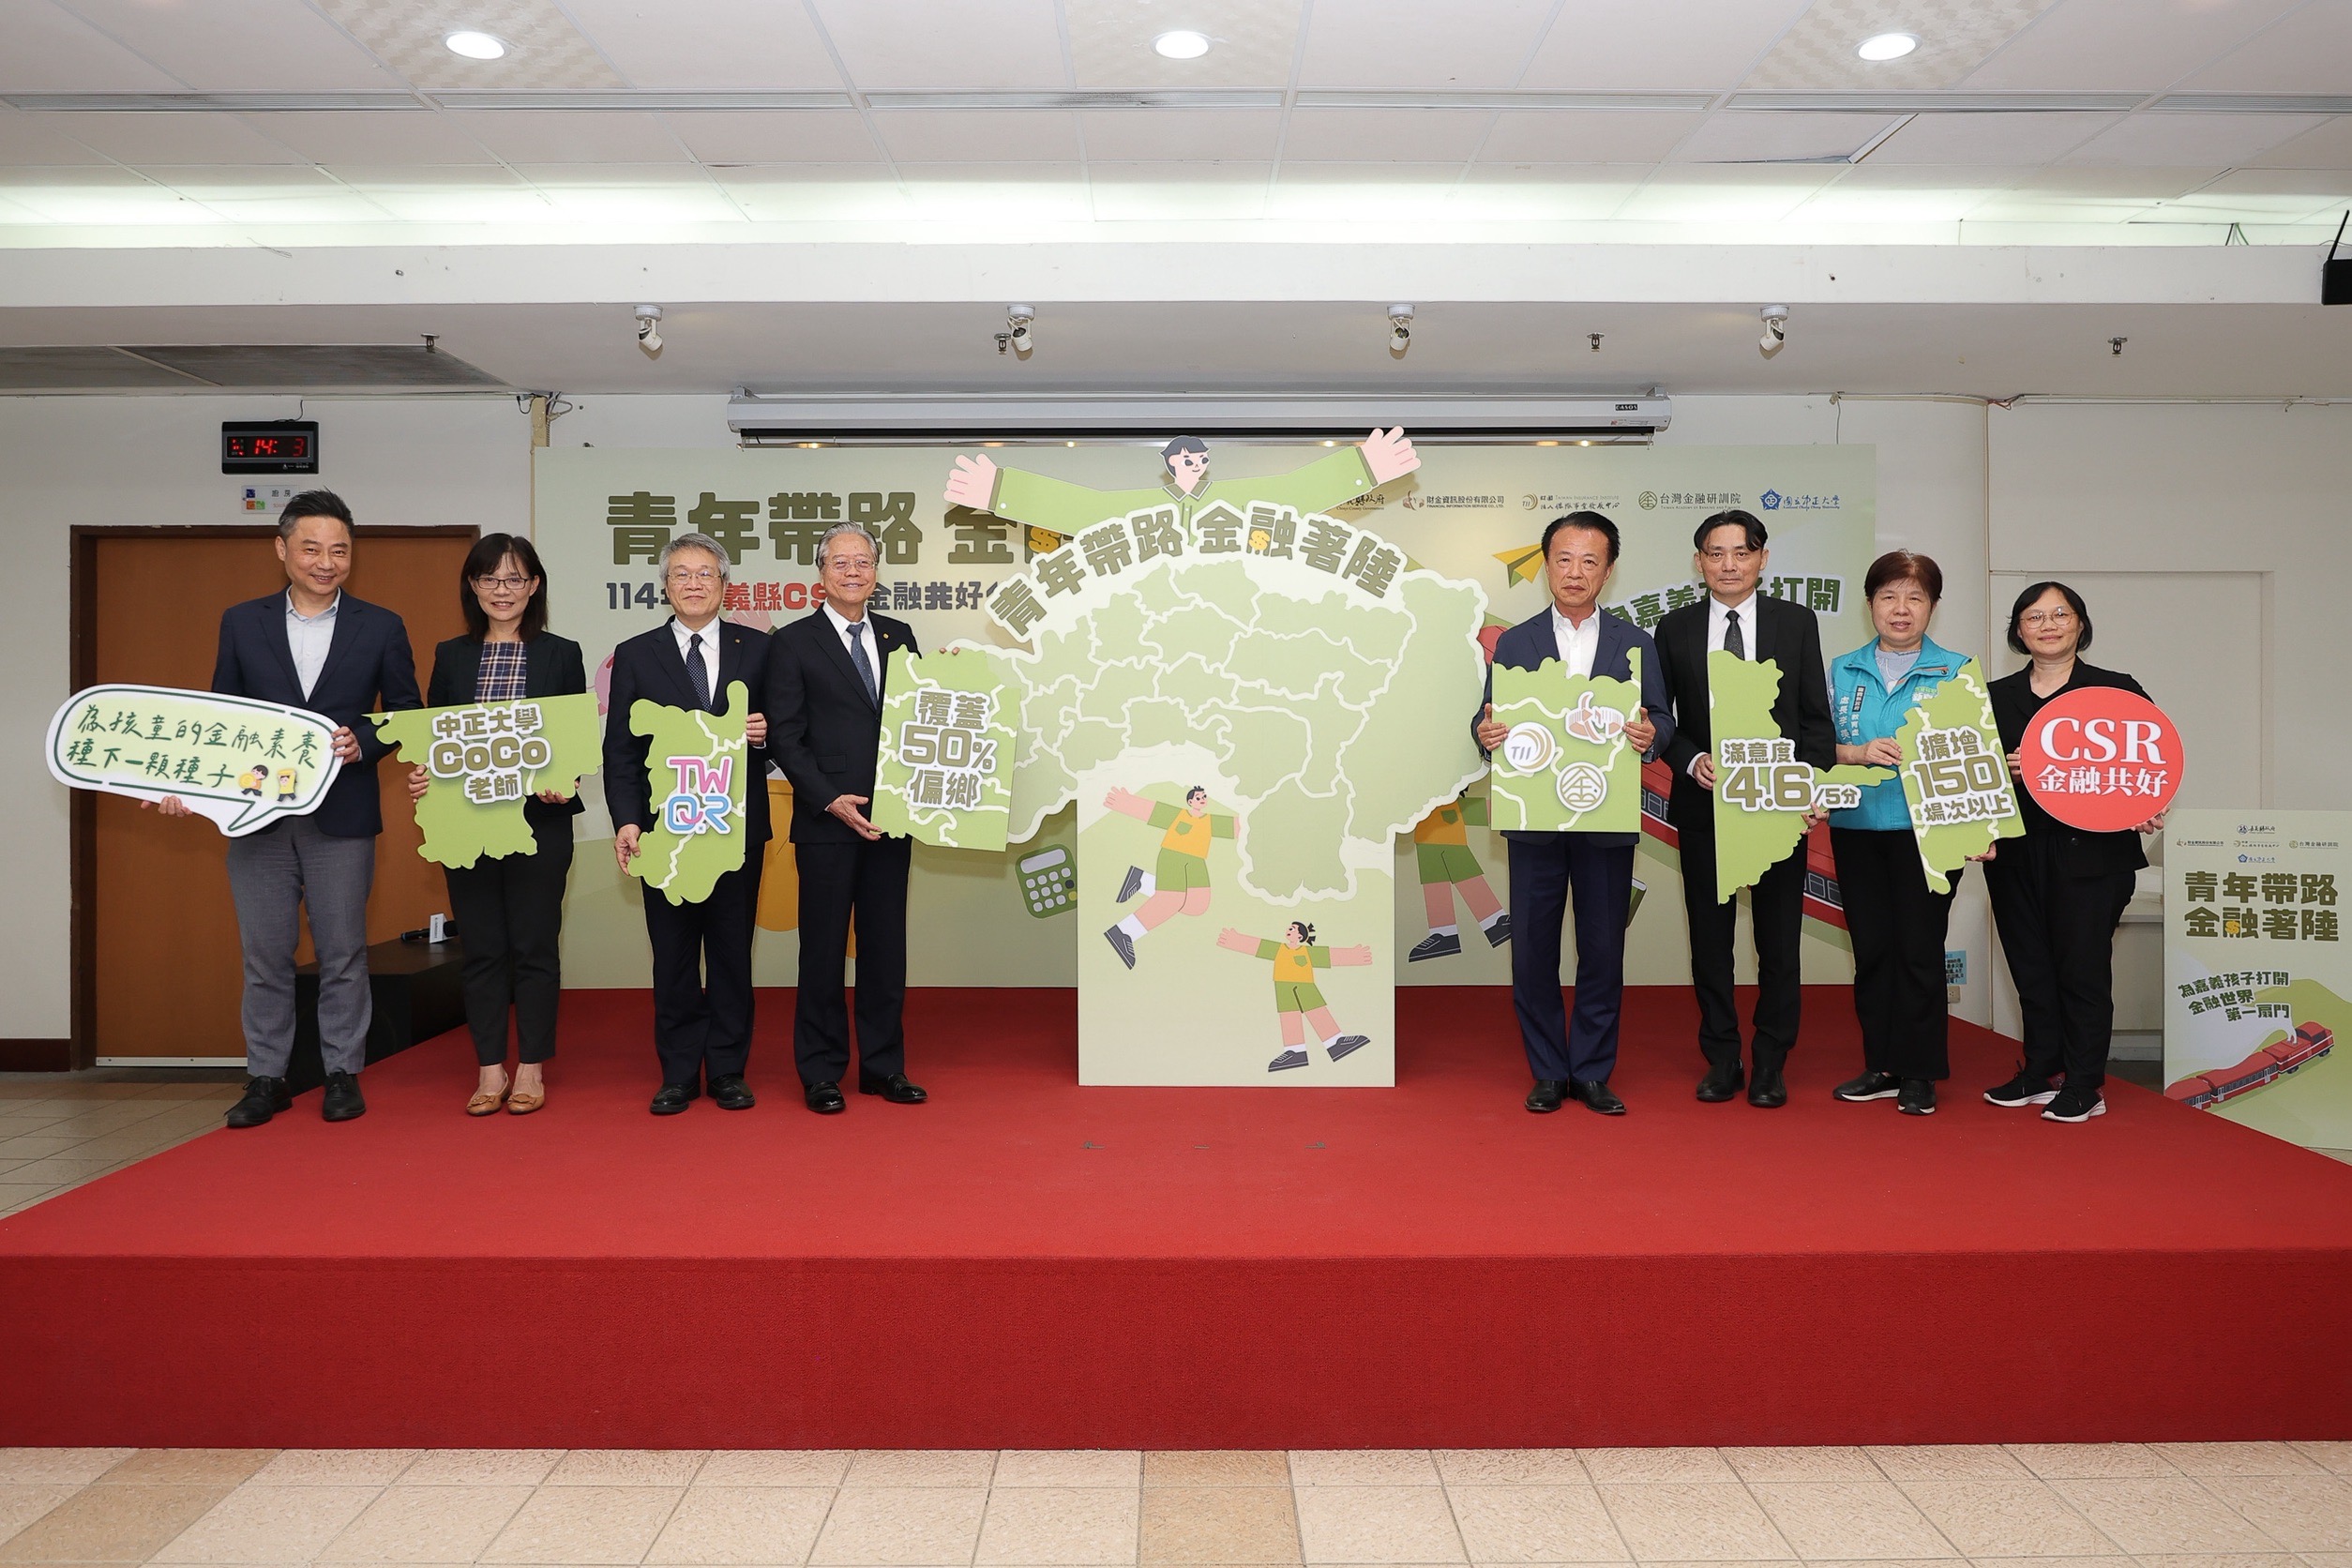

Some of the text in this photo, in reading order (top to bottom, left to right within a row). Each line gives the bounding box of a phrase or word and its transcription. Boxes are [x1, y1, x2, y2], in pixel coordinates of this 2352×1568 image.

[1426, 495, 1504, 504] 財金資訊股份有限公司
[1660, 492, 1741, 505] 台灣金融研訓院
[607, 491, 922, 565] 青年帶路
[990, 505, 1401, 636] 青年帶路 金融著陸
[436, 707, 538, 738] 中正大學
[918, 690, 987, 731] 覆蓋
[78, 704, 318, 769] 為孩童的金融素養
[902, 725, 994, 770] 50%
[1725, 741, 1791, 764] 滿意度
[1921, 730, 1978, 761] 擴增
[2040, 716, 2167, 764] CSR
[67, 738, 234, 788] 種下一顆種子
[433, 736, 547, 774] CoCo
[468, 774, 519, 800] 老師
[670, 759, 730, 793] TW
[910, 769, 978, 807] 偏鄉
[1913, 755, 2002, 798] 150
[2036, 763, 2168, 797] 金融共好
[1924, 793, 2012, 822] 場次以上
[2184, 871, 2338, 906] 青年帶路
[2184, 906, 2339, 942] 金融著陸
[2178, 971, 2289, 998] 為嘉義孩子打開
[2188, 989, 2254, 1015] 金融世界
[2225, 1003, 2290, 1022] 第一扇門
